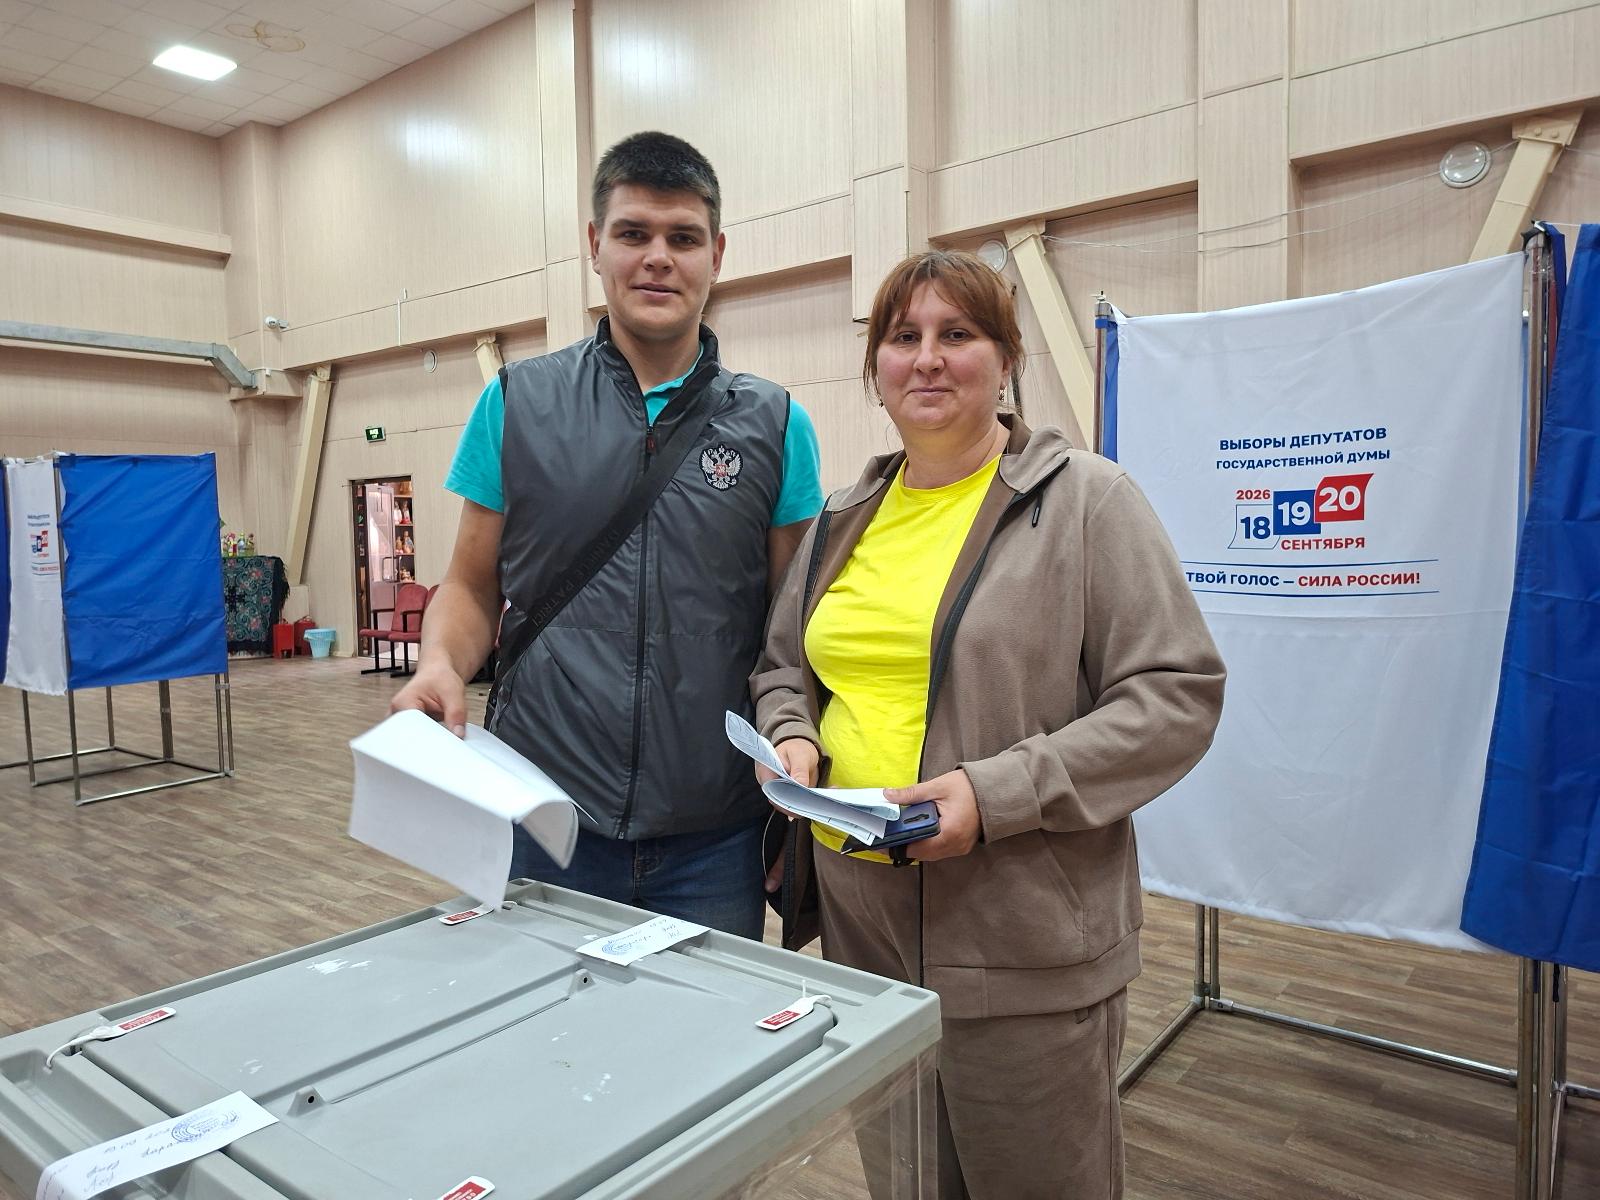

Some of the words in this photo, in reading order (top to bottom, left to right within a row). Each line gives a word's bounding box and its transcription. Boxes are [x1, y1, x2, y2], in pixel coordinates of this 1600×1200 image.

[1219, 437, 1286, 451] ВЫБОРЫ
[1290, 427, 1387, 449] ДЕПУТАТОВ
[1216, 452, 1344, 470] ГОСУДАРСТВЕННОЙ
[1347, 449, 1390, 464] ДУМЫ
[1236, 489, 1271, 500] 2026
[1240, 516, 1271, 540] 18
[1277, 501, 1311, 527] 19
[1318, 485, 1361, 513] 20
[1281, 537, 1365, 551] СЕНТЯБРЯ
[1185, 571, 1227, 585] ТВОЙ
[1230, 574, 1280, 587] ГОЛОС
[1298, 575, 1341, 587] СИЛА
[1347, 572, 1420, 587] РОССИИ!
